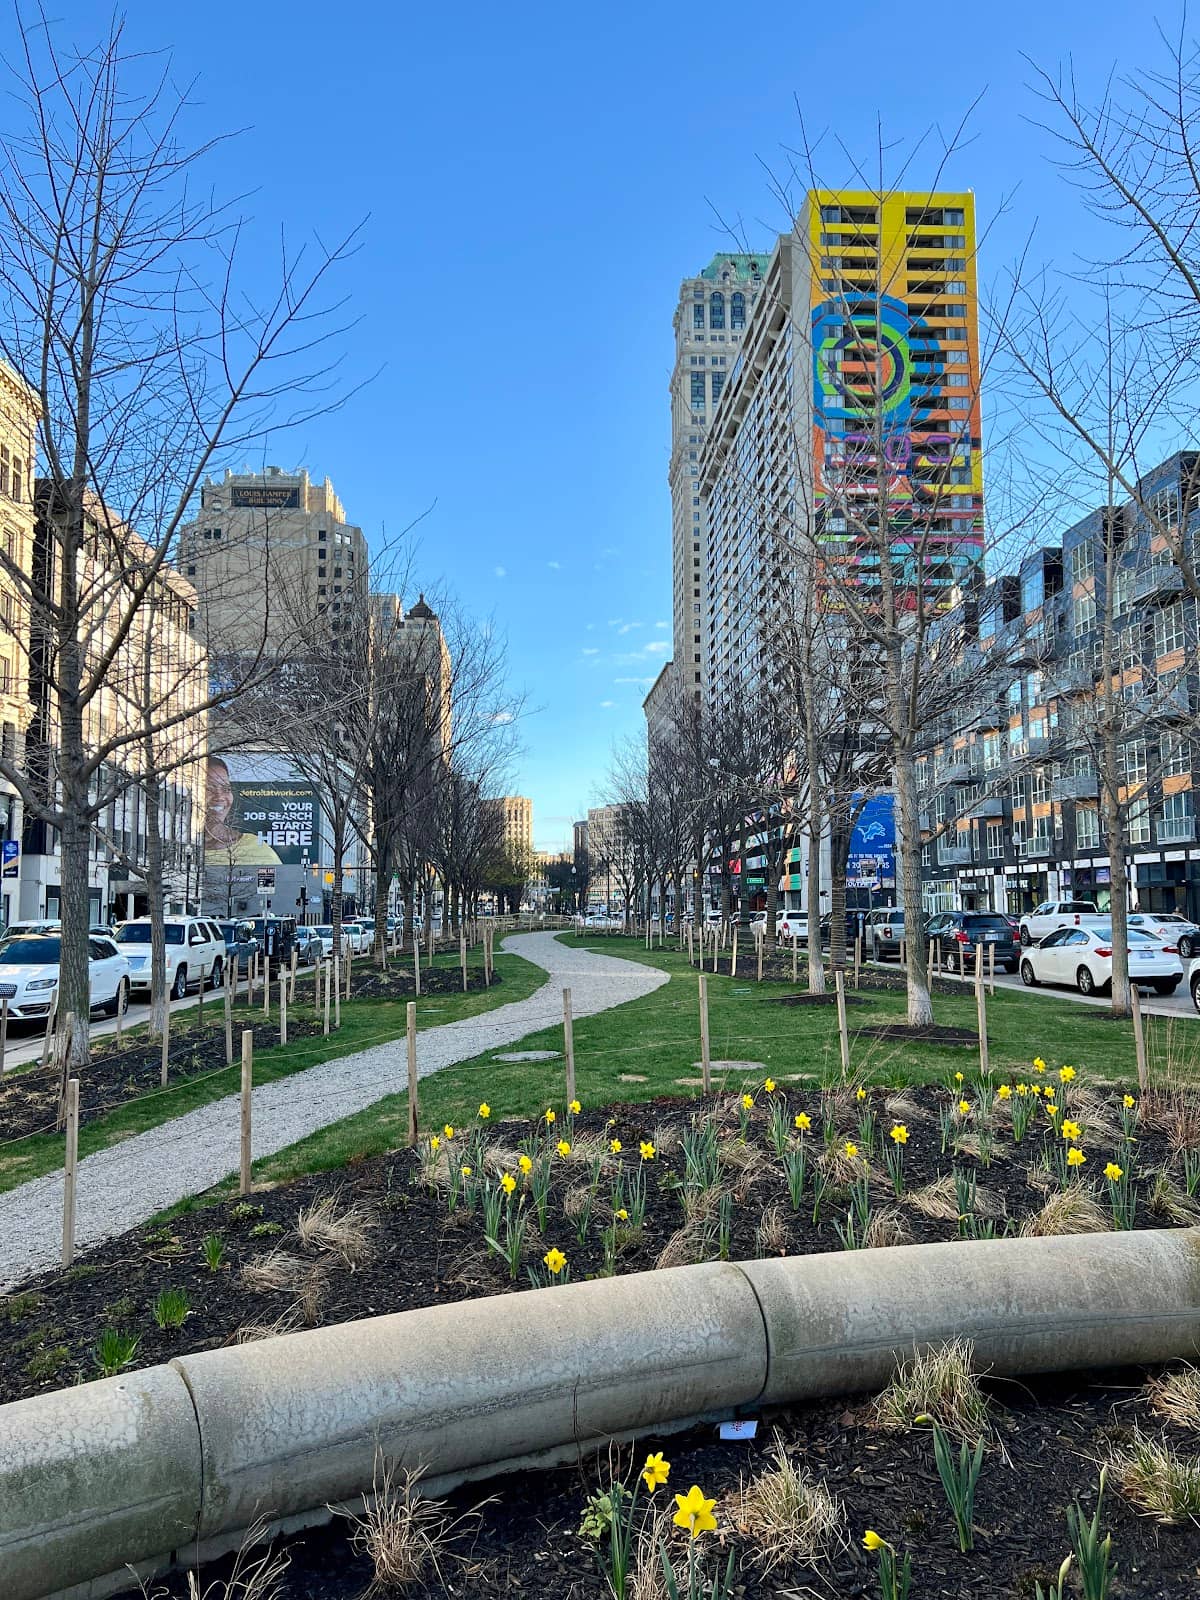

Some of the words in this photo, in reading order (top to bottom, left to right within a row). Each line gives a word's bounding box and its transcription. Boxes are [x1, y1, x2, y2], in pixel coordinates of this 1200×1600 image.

[281, 801, 313, 811] YOUR
[243, 811, 266, 821] JOB
[268, 811, 313, 821] SEARCH
[271, 821, 313, 830] STARTS
[256, 830, 313, 847] HERE
